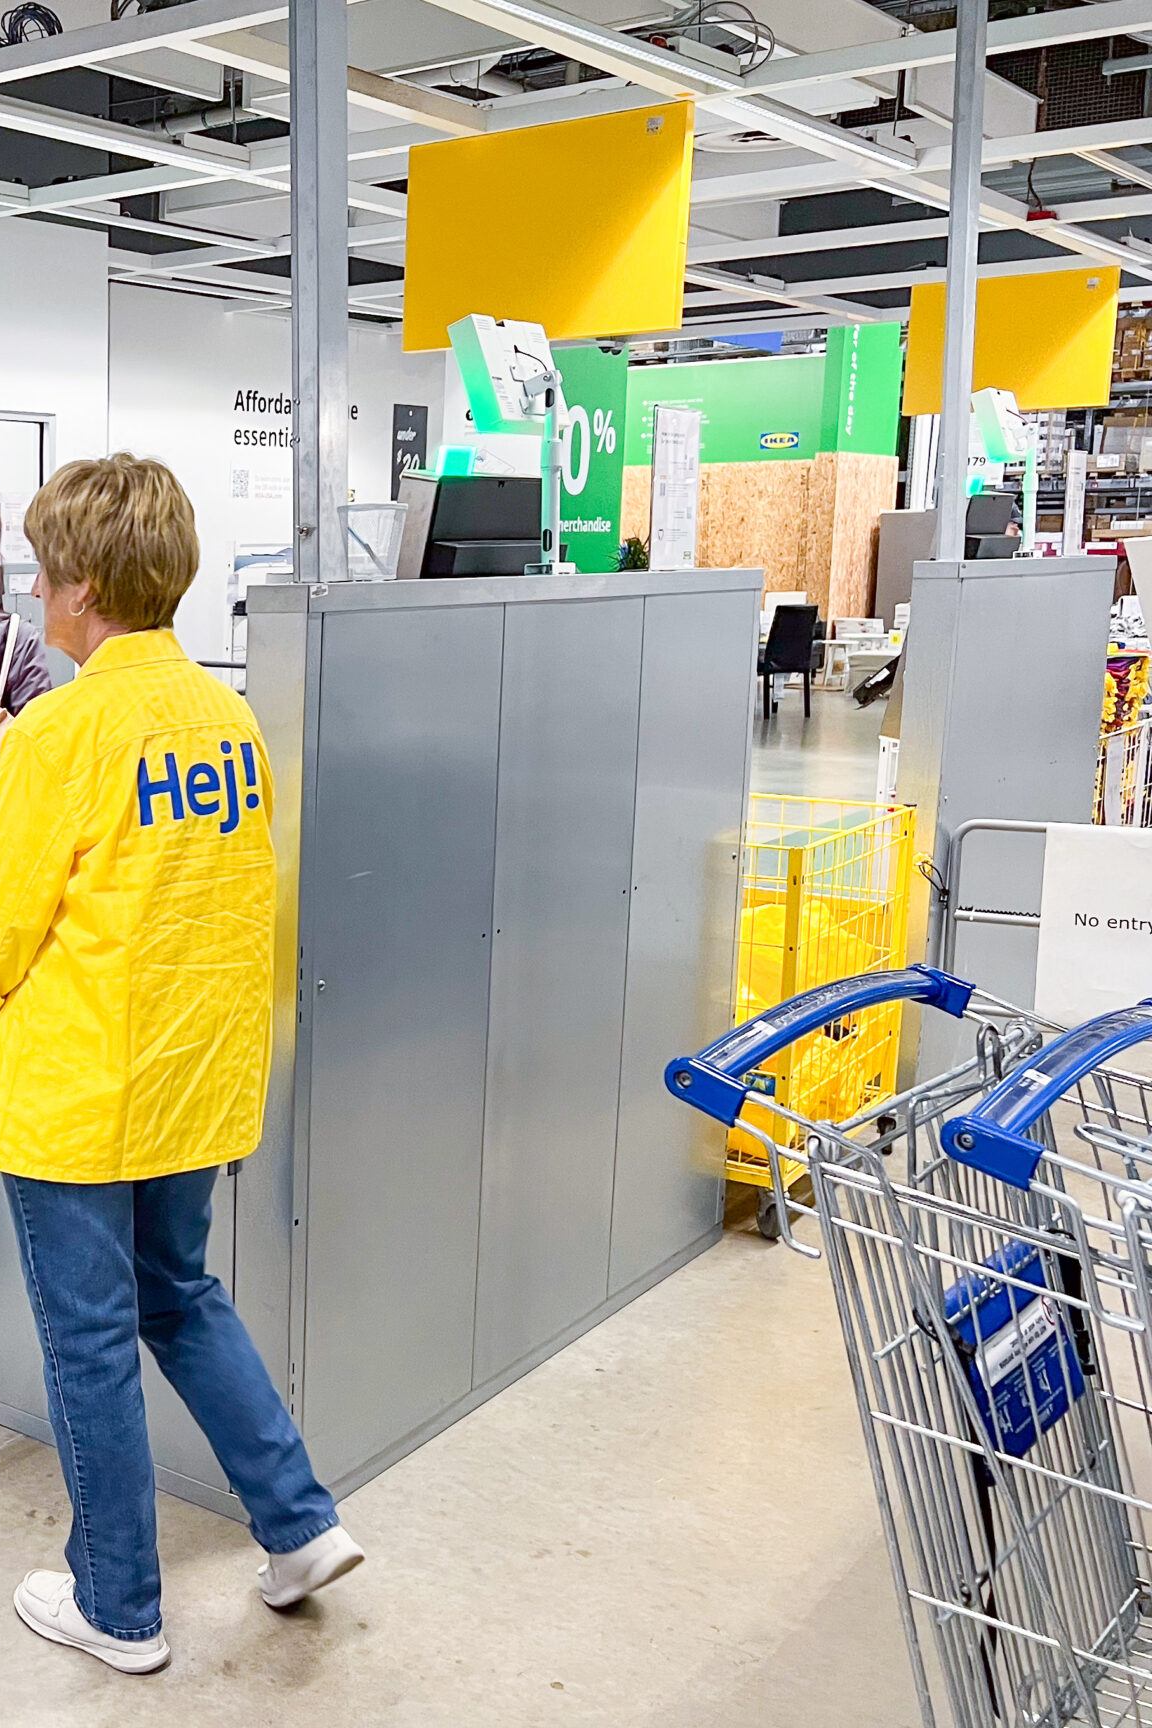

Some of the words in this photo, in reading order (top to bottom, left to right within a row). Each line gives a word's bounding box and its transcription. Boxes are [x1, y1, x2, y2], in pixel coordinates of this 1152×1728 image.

[233, 390, 292, 415] Afforda
[233, 426, 293, 448] essenti
[763, 436, 796, 445] IKEA
[560, 404, 617, 496] 0%
[137, 740, 259, 834] Hej!
[1074, 912, 1099, 927] No
